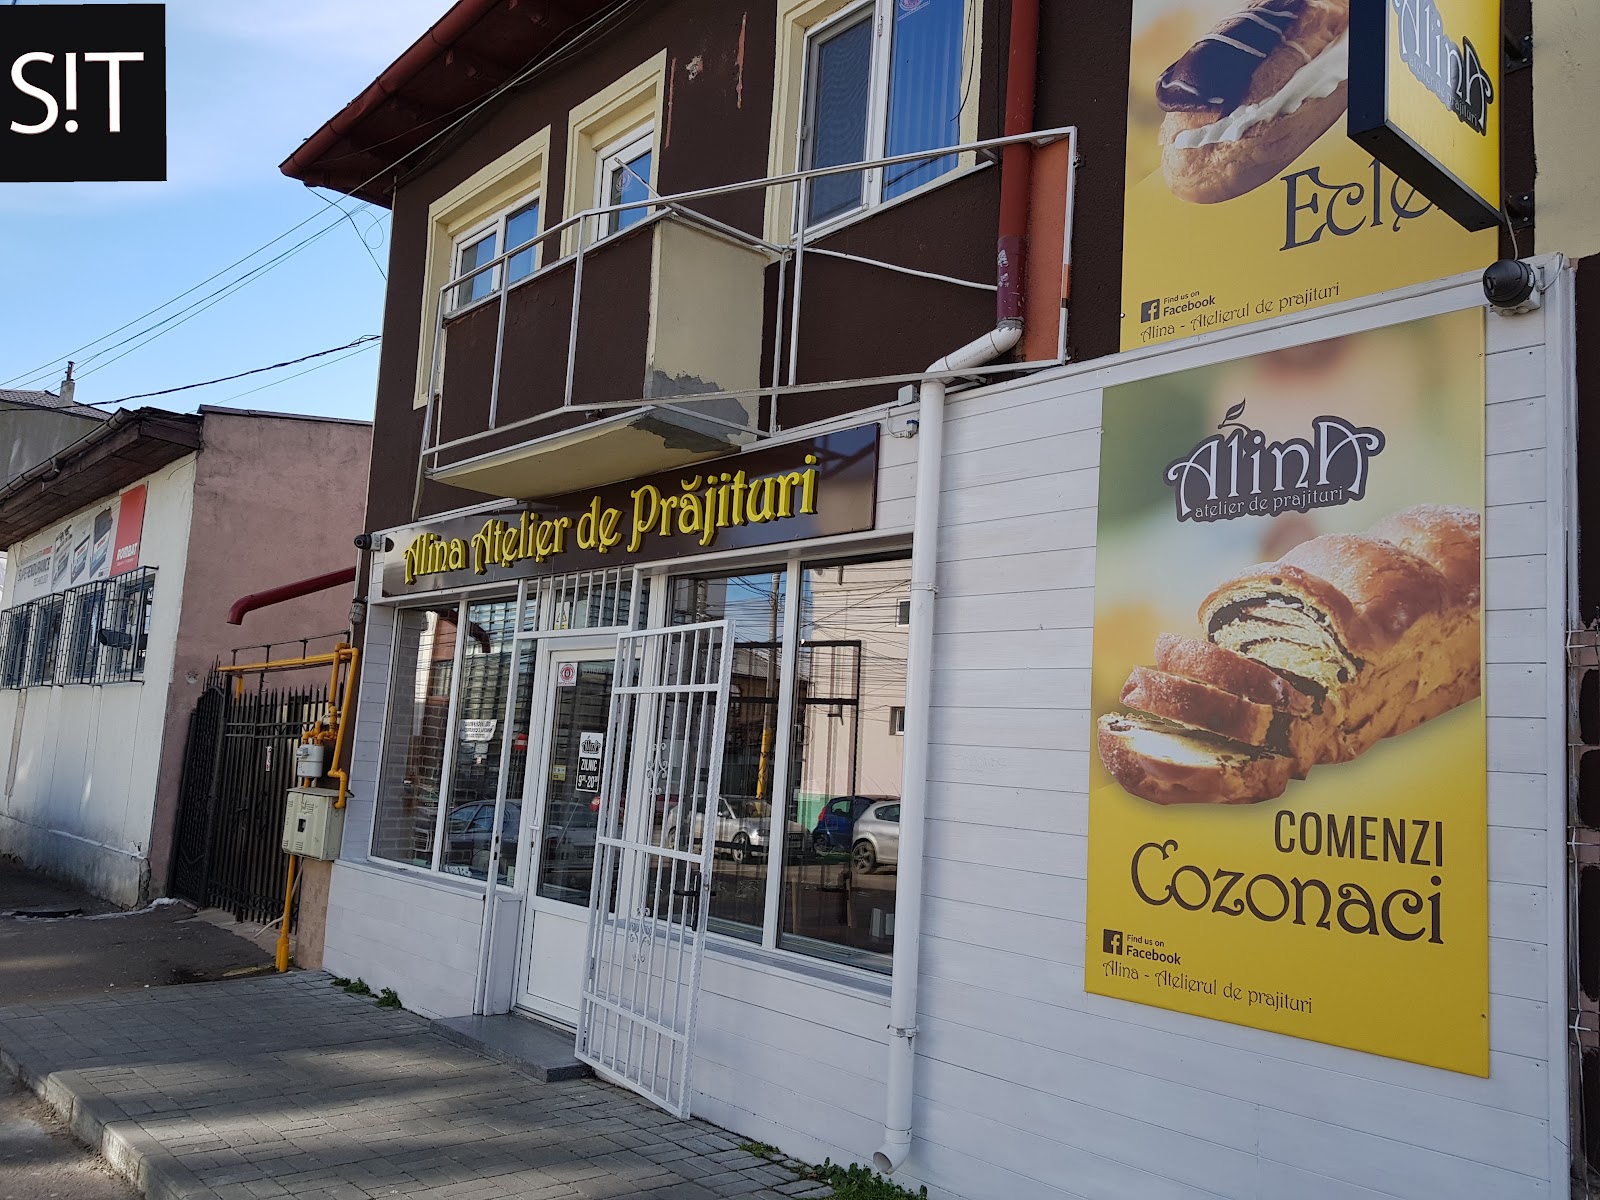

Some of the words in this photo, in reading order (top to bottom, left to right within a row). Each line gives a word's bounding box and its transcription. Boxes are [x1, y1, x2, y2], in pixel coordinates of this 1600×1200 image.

[1447, 92, 1478, 127] prajituri
[1140, 324, 1175, 343] Alina
[1190, 302, 1249, 331] Atelierul
[1255, 301, 1274, 315] de
[1278, 282, 1340, 312] prajituri
[1163, 294, 1178, 304] Find
[1180, 293, 1189, 301] us
[1190, 290, 1200, 299] on
[1163, 294, 1216, 317] Facebook
[1195, 501, 1244, 519] atelier
[1249, 494, 1269, 512] de
[1273, 485, 1343, 512] prajituri
[403, 530, 466, 585] Alina
[470, 511, 572, 575] Atelier
[576, 495, 621, 554] de
[626, 455, 821, 553] Prăjituri
[1274, 809, 1444, 868] COMENZI
[1130, 838, 1445, 945] Cozonaci
[1126, 934, 1143, 944] Find
[1144, 937, 1153, 946] us
[1154, 940, 1165, 948] on
[1126, 945, 1182, 966] Facebook
[1102, 960, 1139, 980] Alina
[1154, 970, 1217, 995] Atelierul
[1223, 982, 1243, 1001] de
[1247, 989, 1313, 1014] prajituri
